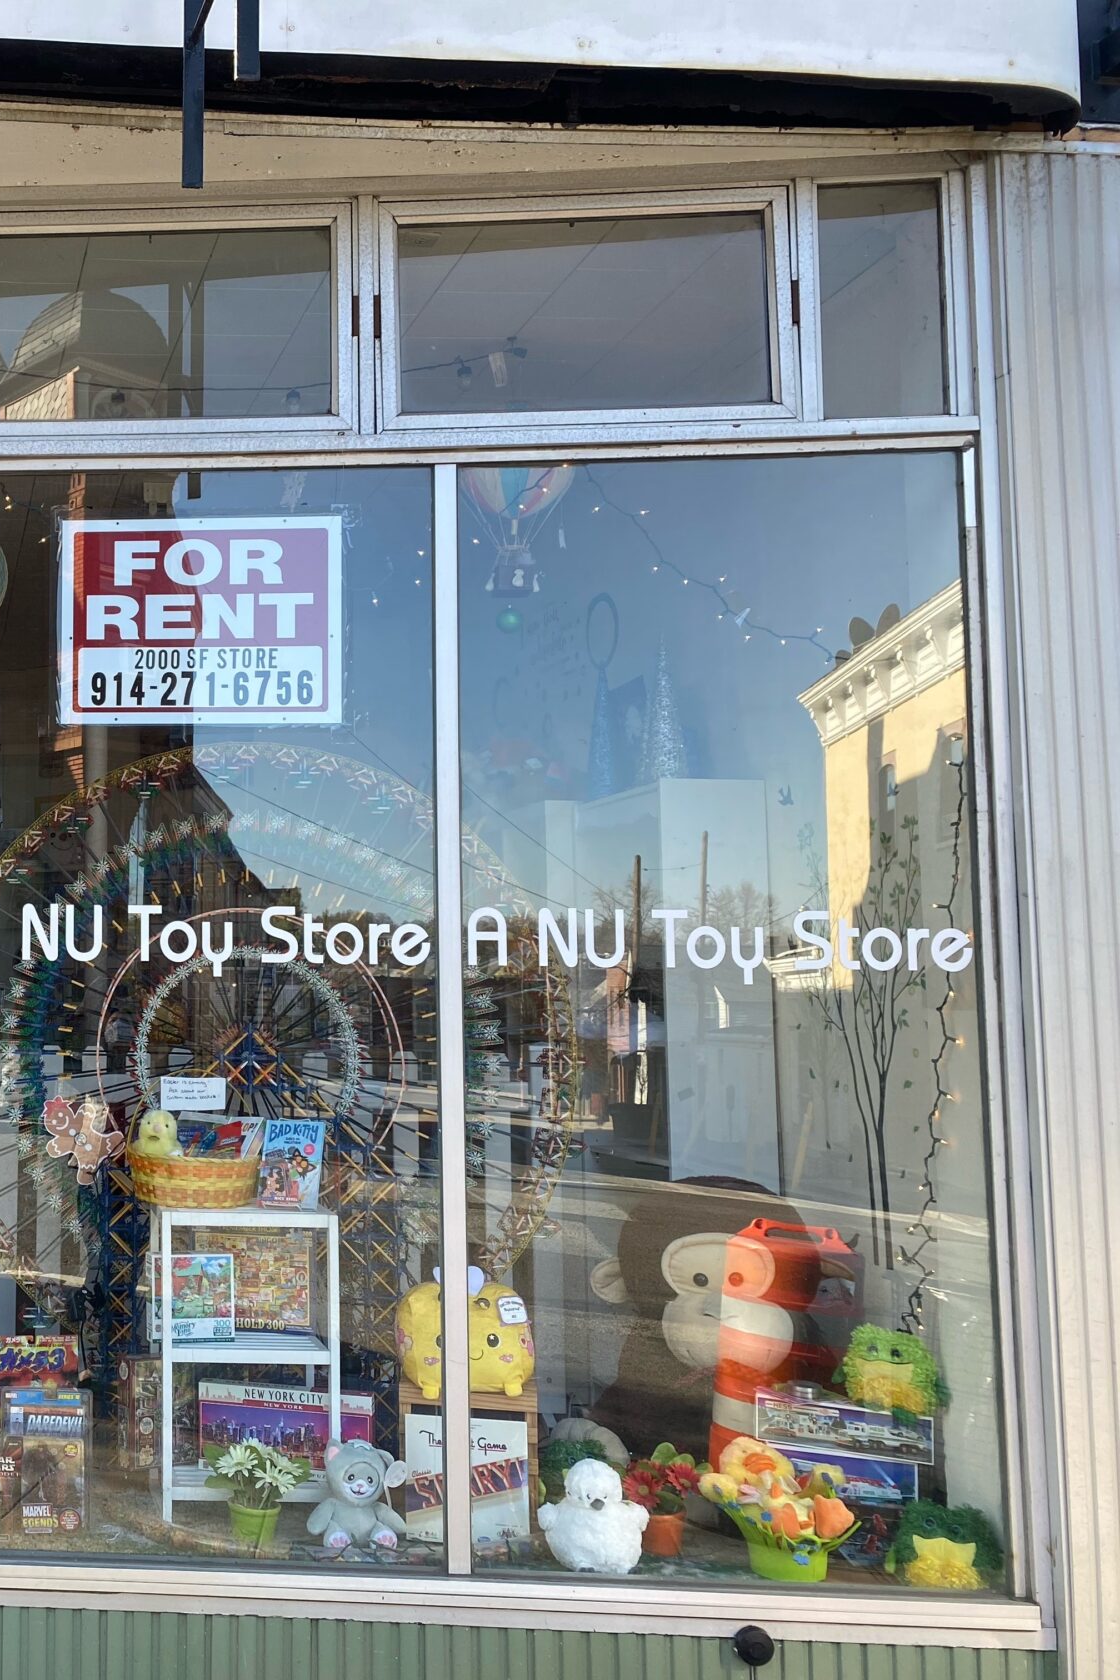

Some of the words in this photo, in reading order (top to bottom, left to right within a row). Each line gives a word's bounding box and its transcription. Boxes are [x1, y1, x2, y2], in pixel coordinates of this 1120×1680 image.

[113, 538, 284, 586] FOR
[85, 592, 314, 640] RENT
[134, 648, 181, 670] 2000
[186, 648, 209, 669] SF
[217, 648, 279, 669] STORE
[90, 670, 314, 707] 914-271-6756
[22, 904, 102, 962] NU
[128, 905, 234, 977] Toy
[261, 906, 431, 966] Store
[467, 907, 508, 967] A
[538, 907, 625, 968] NU
[651, 909, 765, 985] Toy
[793, 911, 974, 972] Store
[241, 1122, 259, 1134] OP!
[269, 1124, 292, 1143] BAD
[235, 1318, 264, 1329] HOLD
[266, 1319, 285, 1331] 300
[244, 1387, 268, 1401] NEW
[269, 1389, 295, 1403] YORK
[299, 1392, 323, 1405] CITY
[27, 1414, 83, 1433] DAREDEVIL
[419, 1430, 443, 1446] The
[477, 1437, 508, 1456] Game
[414, 1456, 523, 1508] SRY!
[22, 1505, 51, 1518] MARVEL
[22, 1514, 59, 1528] EGENDS
